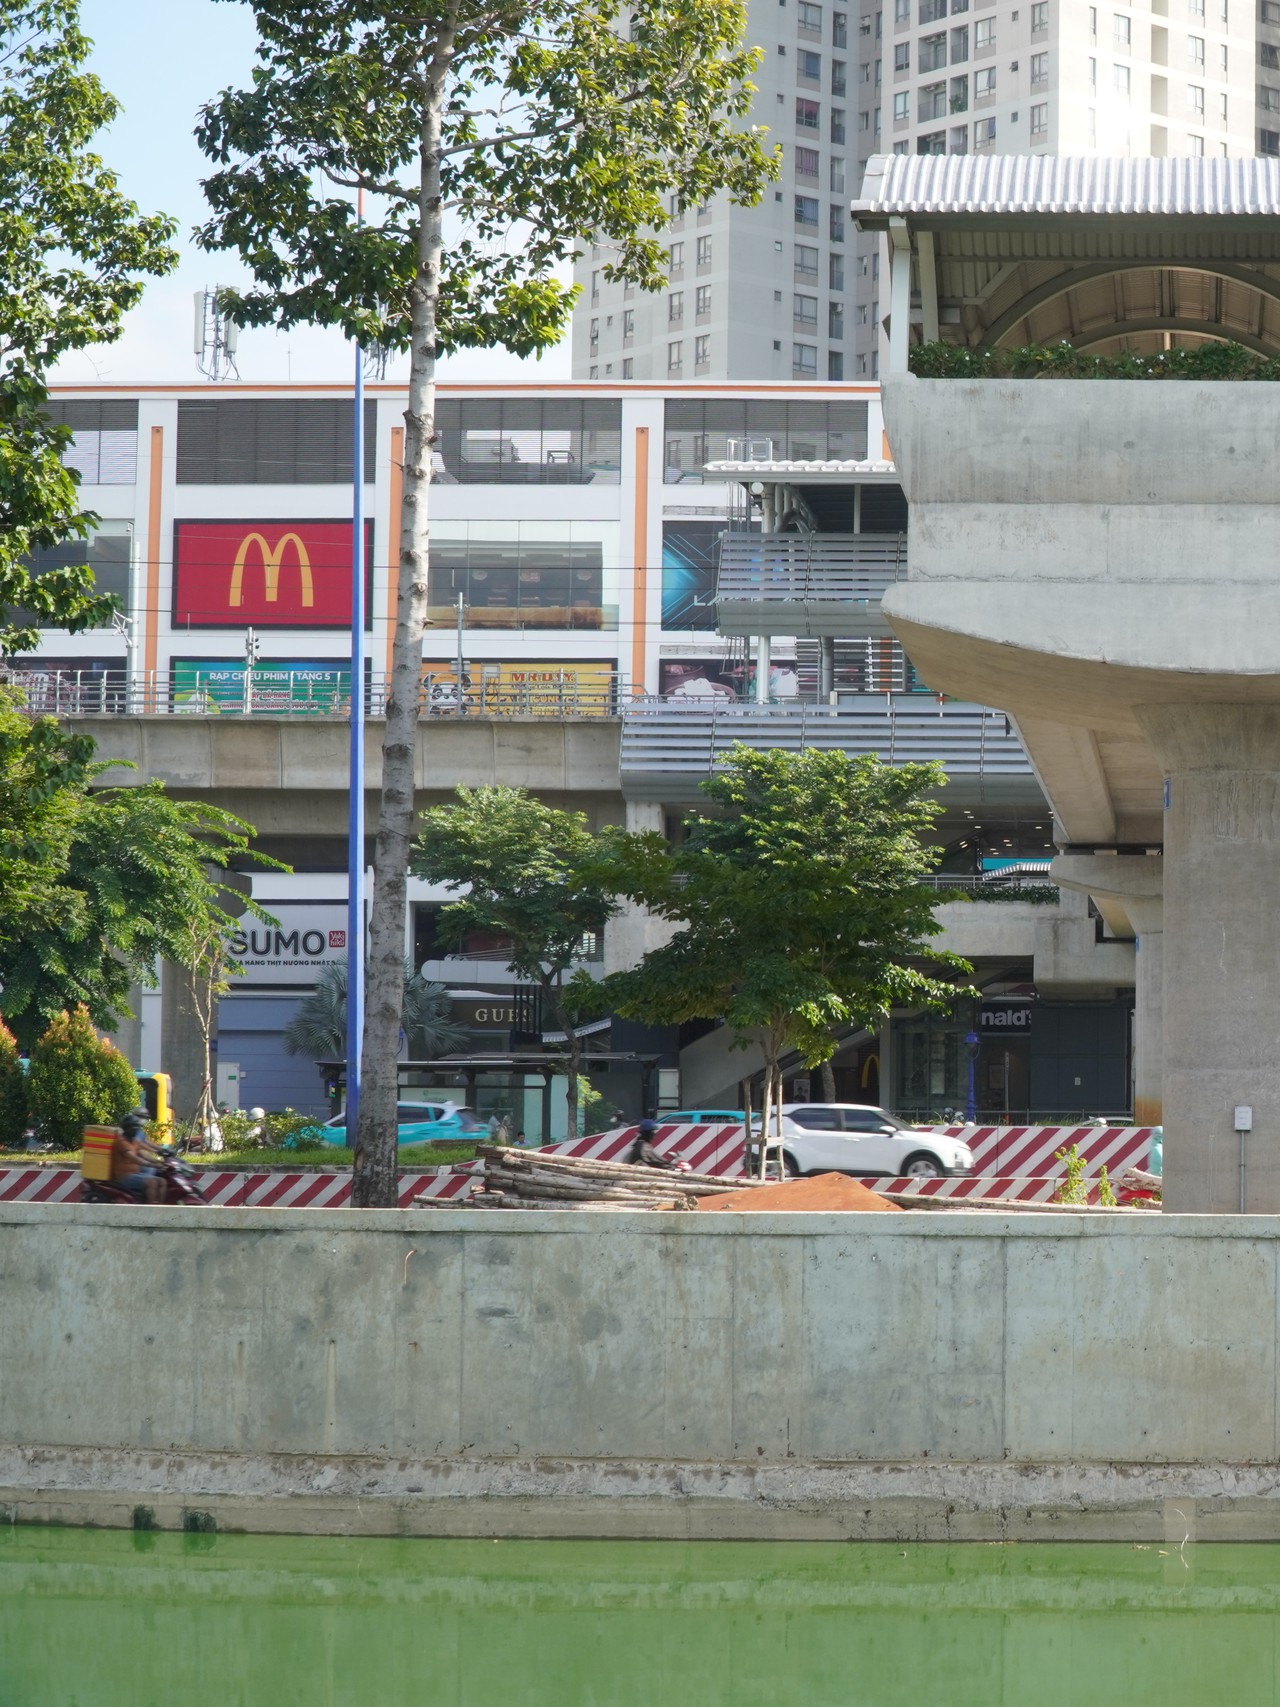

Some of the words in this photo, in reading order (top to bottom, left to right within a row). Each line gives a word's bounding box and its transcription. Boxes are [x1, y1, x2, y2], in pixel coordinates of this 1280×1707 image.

[263, 672, 288, 680] PHIM
[324, 672, 331, 680] 5
[229, 930, 325, 956] SUMO
